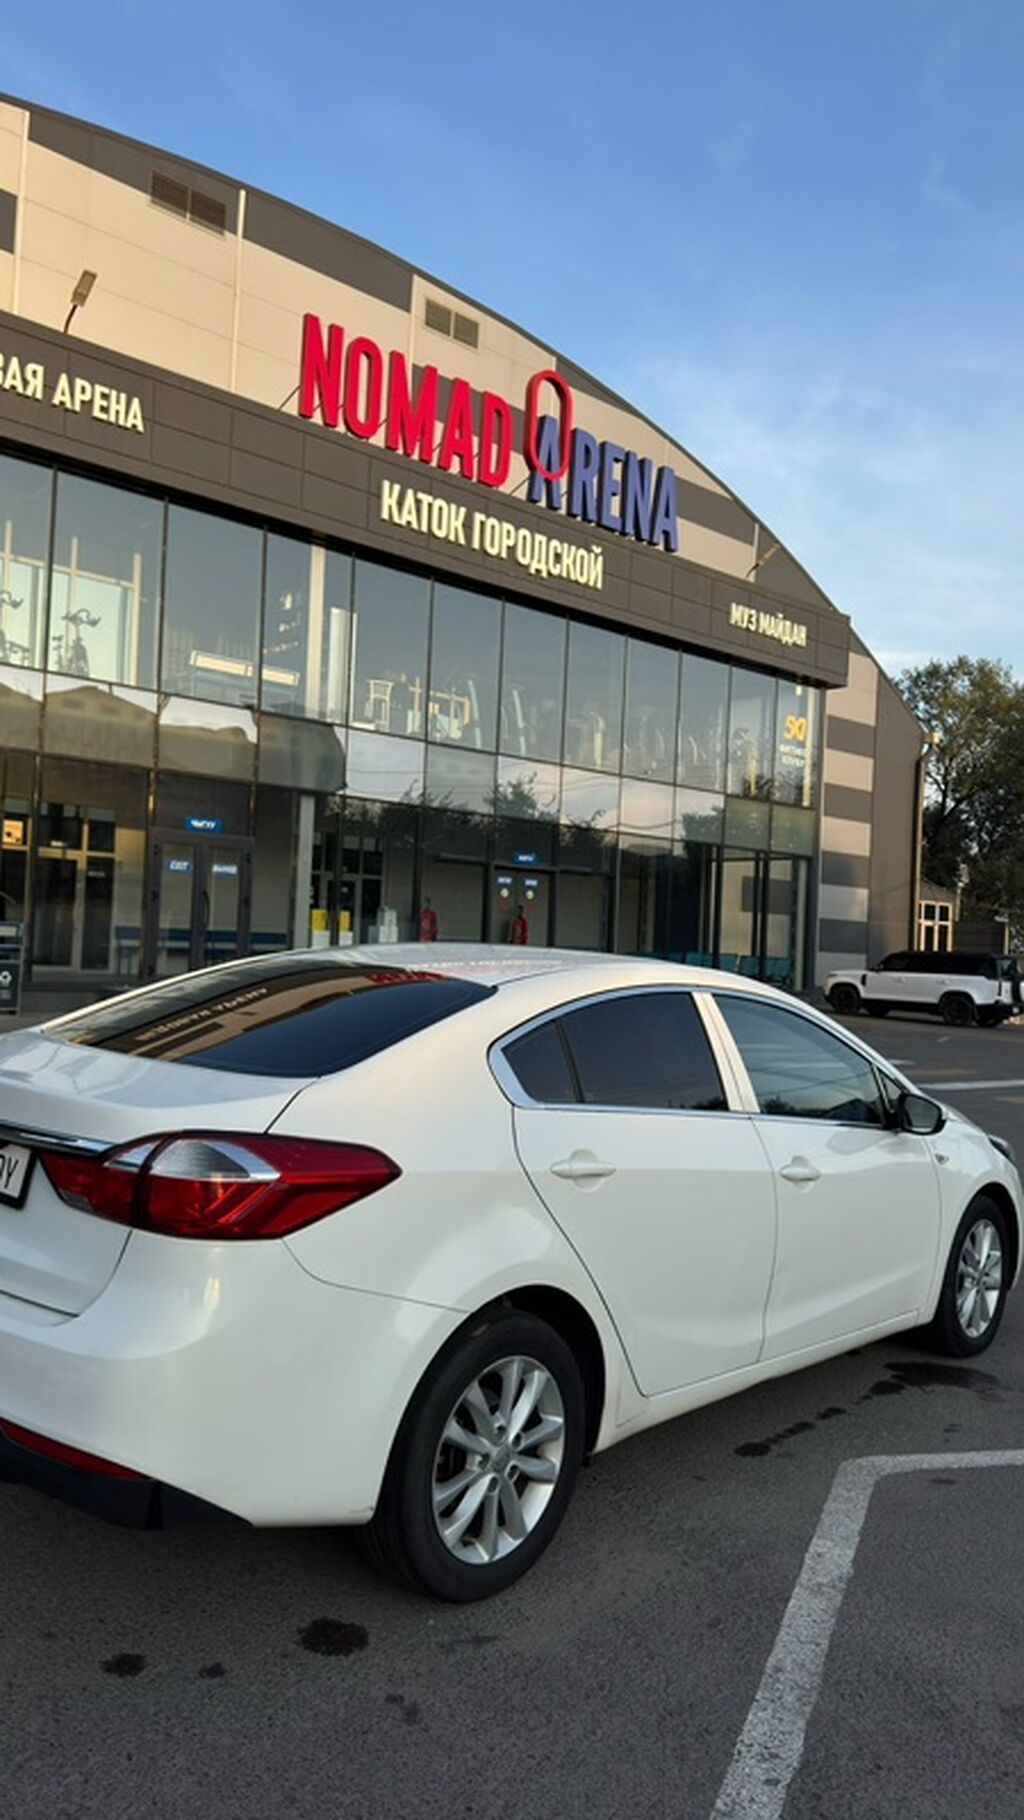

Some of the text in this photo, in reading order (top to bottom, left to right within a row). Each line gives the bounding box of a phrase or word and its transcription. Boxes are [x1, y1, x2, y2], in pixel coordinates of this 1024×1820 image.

[52, 372, 144, 433] АРЕНА
[299, 313, 680, 553] NOMAD ARENA
[381, 480, 604, 590] КАТОК ГОРОДСКОЙ
[730, 602, 807, 647] МУЗ МАЙДАН
